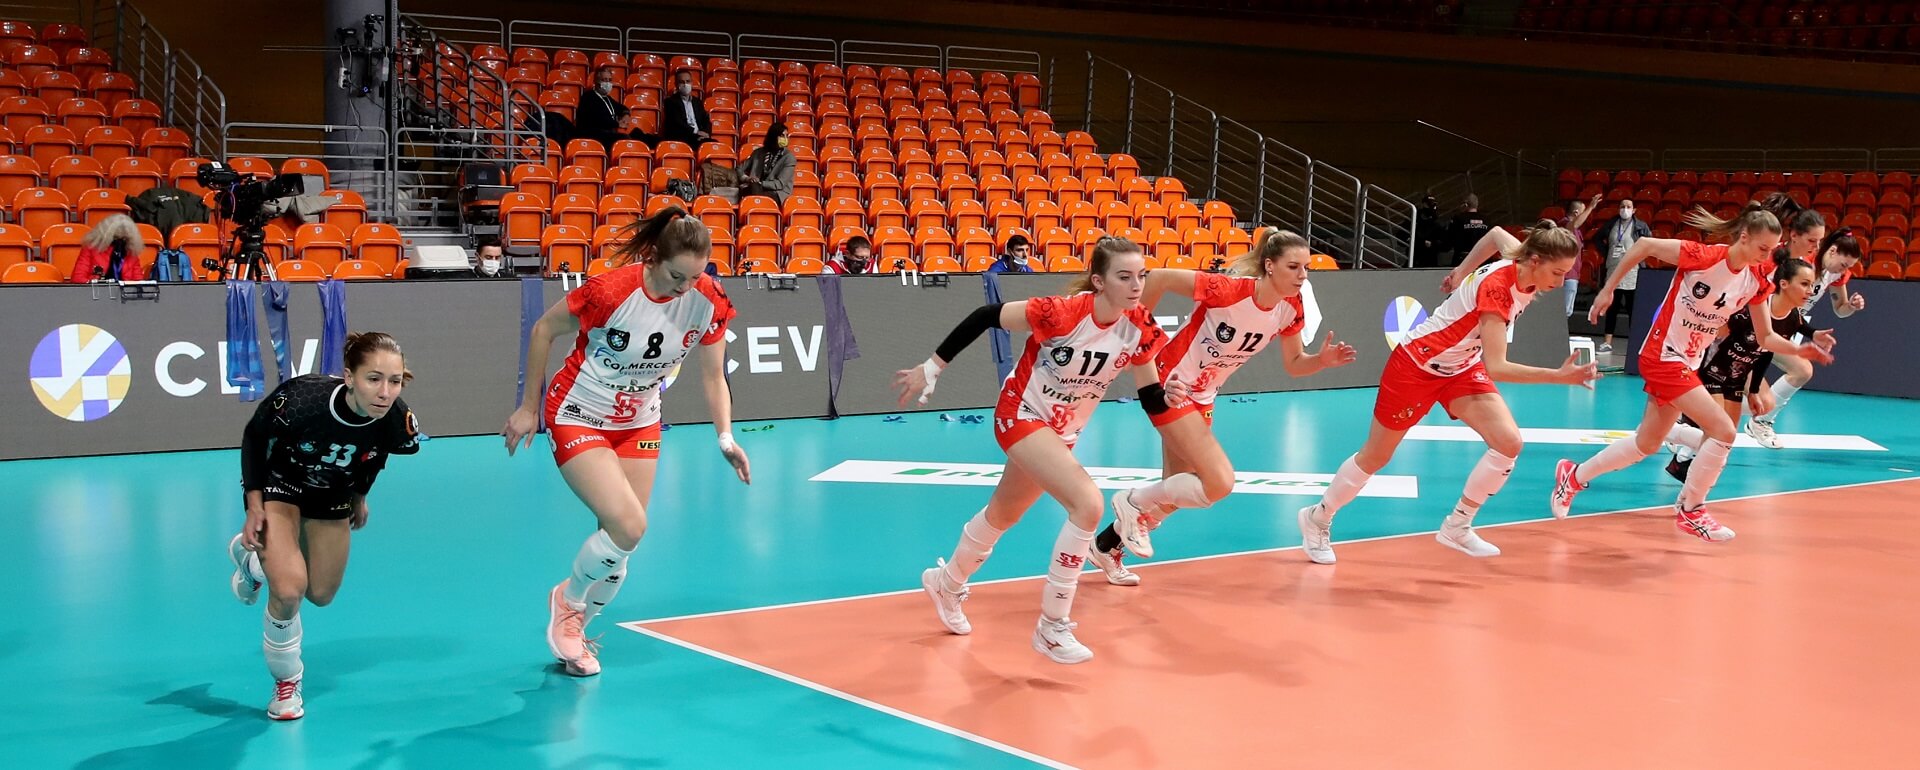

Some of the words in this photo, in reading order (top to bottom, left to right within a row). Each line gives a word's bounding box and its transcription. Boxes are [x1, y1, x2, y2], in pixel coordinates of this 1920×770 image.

[1713, 292, 1726, 310] 4
[643, 332, 664, 359] 8
[1237, 332, 1264, 352] 12
[1078, 351, 1110, 376] 17
[320, 443, 357, 468] 33
